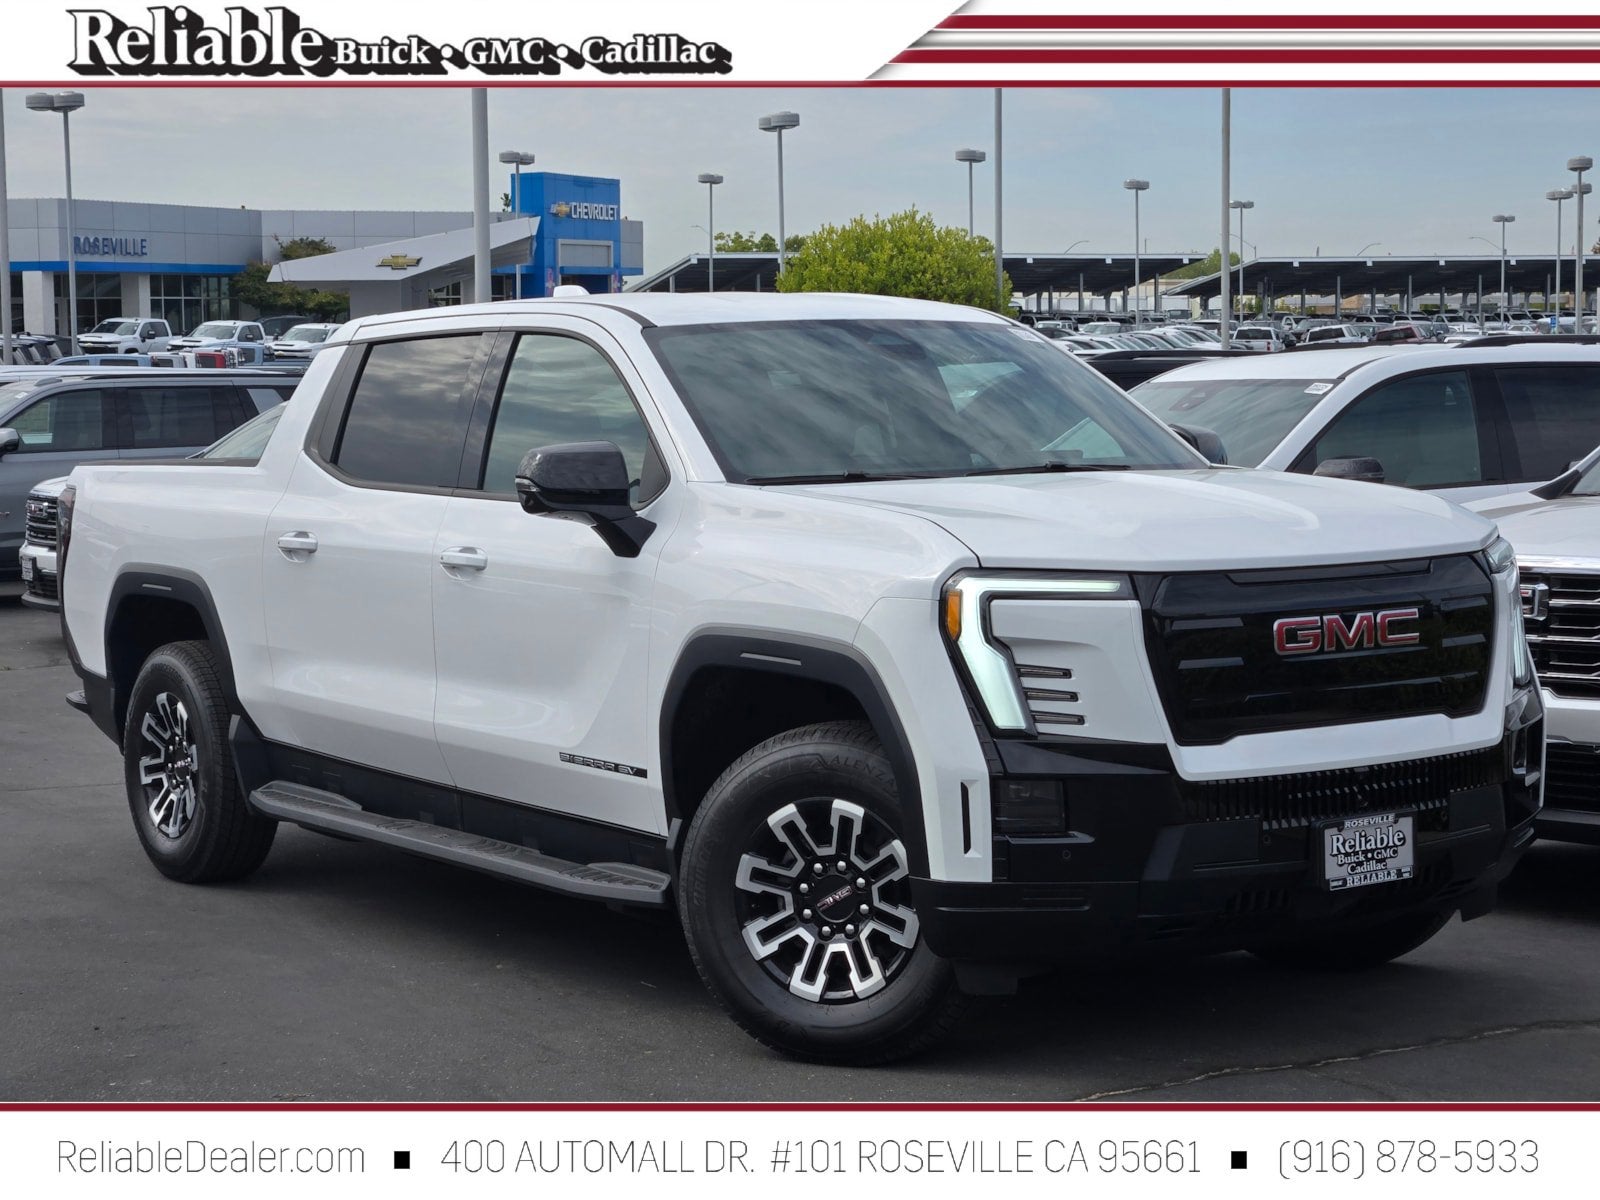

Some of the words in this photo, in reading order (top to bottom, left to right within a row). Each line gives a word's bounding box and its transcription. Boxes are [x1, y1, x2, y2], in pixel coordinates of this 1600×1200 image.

[570, 202, 618, 220] CHEVROLET
[73, 236, 147, 256] ROSEVILLE
[1273, 608, 1420, 656] GMC
[560, 753, 614, 771] SIERRA
[618, 765, 637, 775] EV
[1344, 814, 1396, 829] ROSEVILLE
[1331, 826, 1405, 856] Reliable
[1337, 851, 1366, 866] Buick
[1373, 846, 1399, 860] GMC
[1347, 860, 1387, 875] Cadillac
[1346, 869, 1397, 888] RELIABLE
